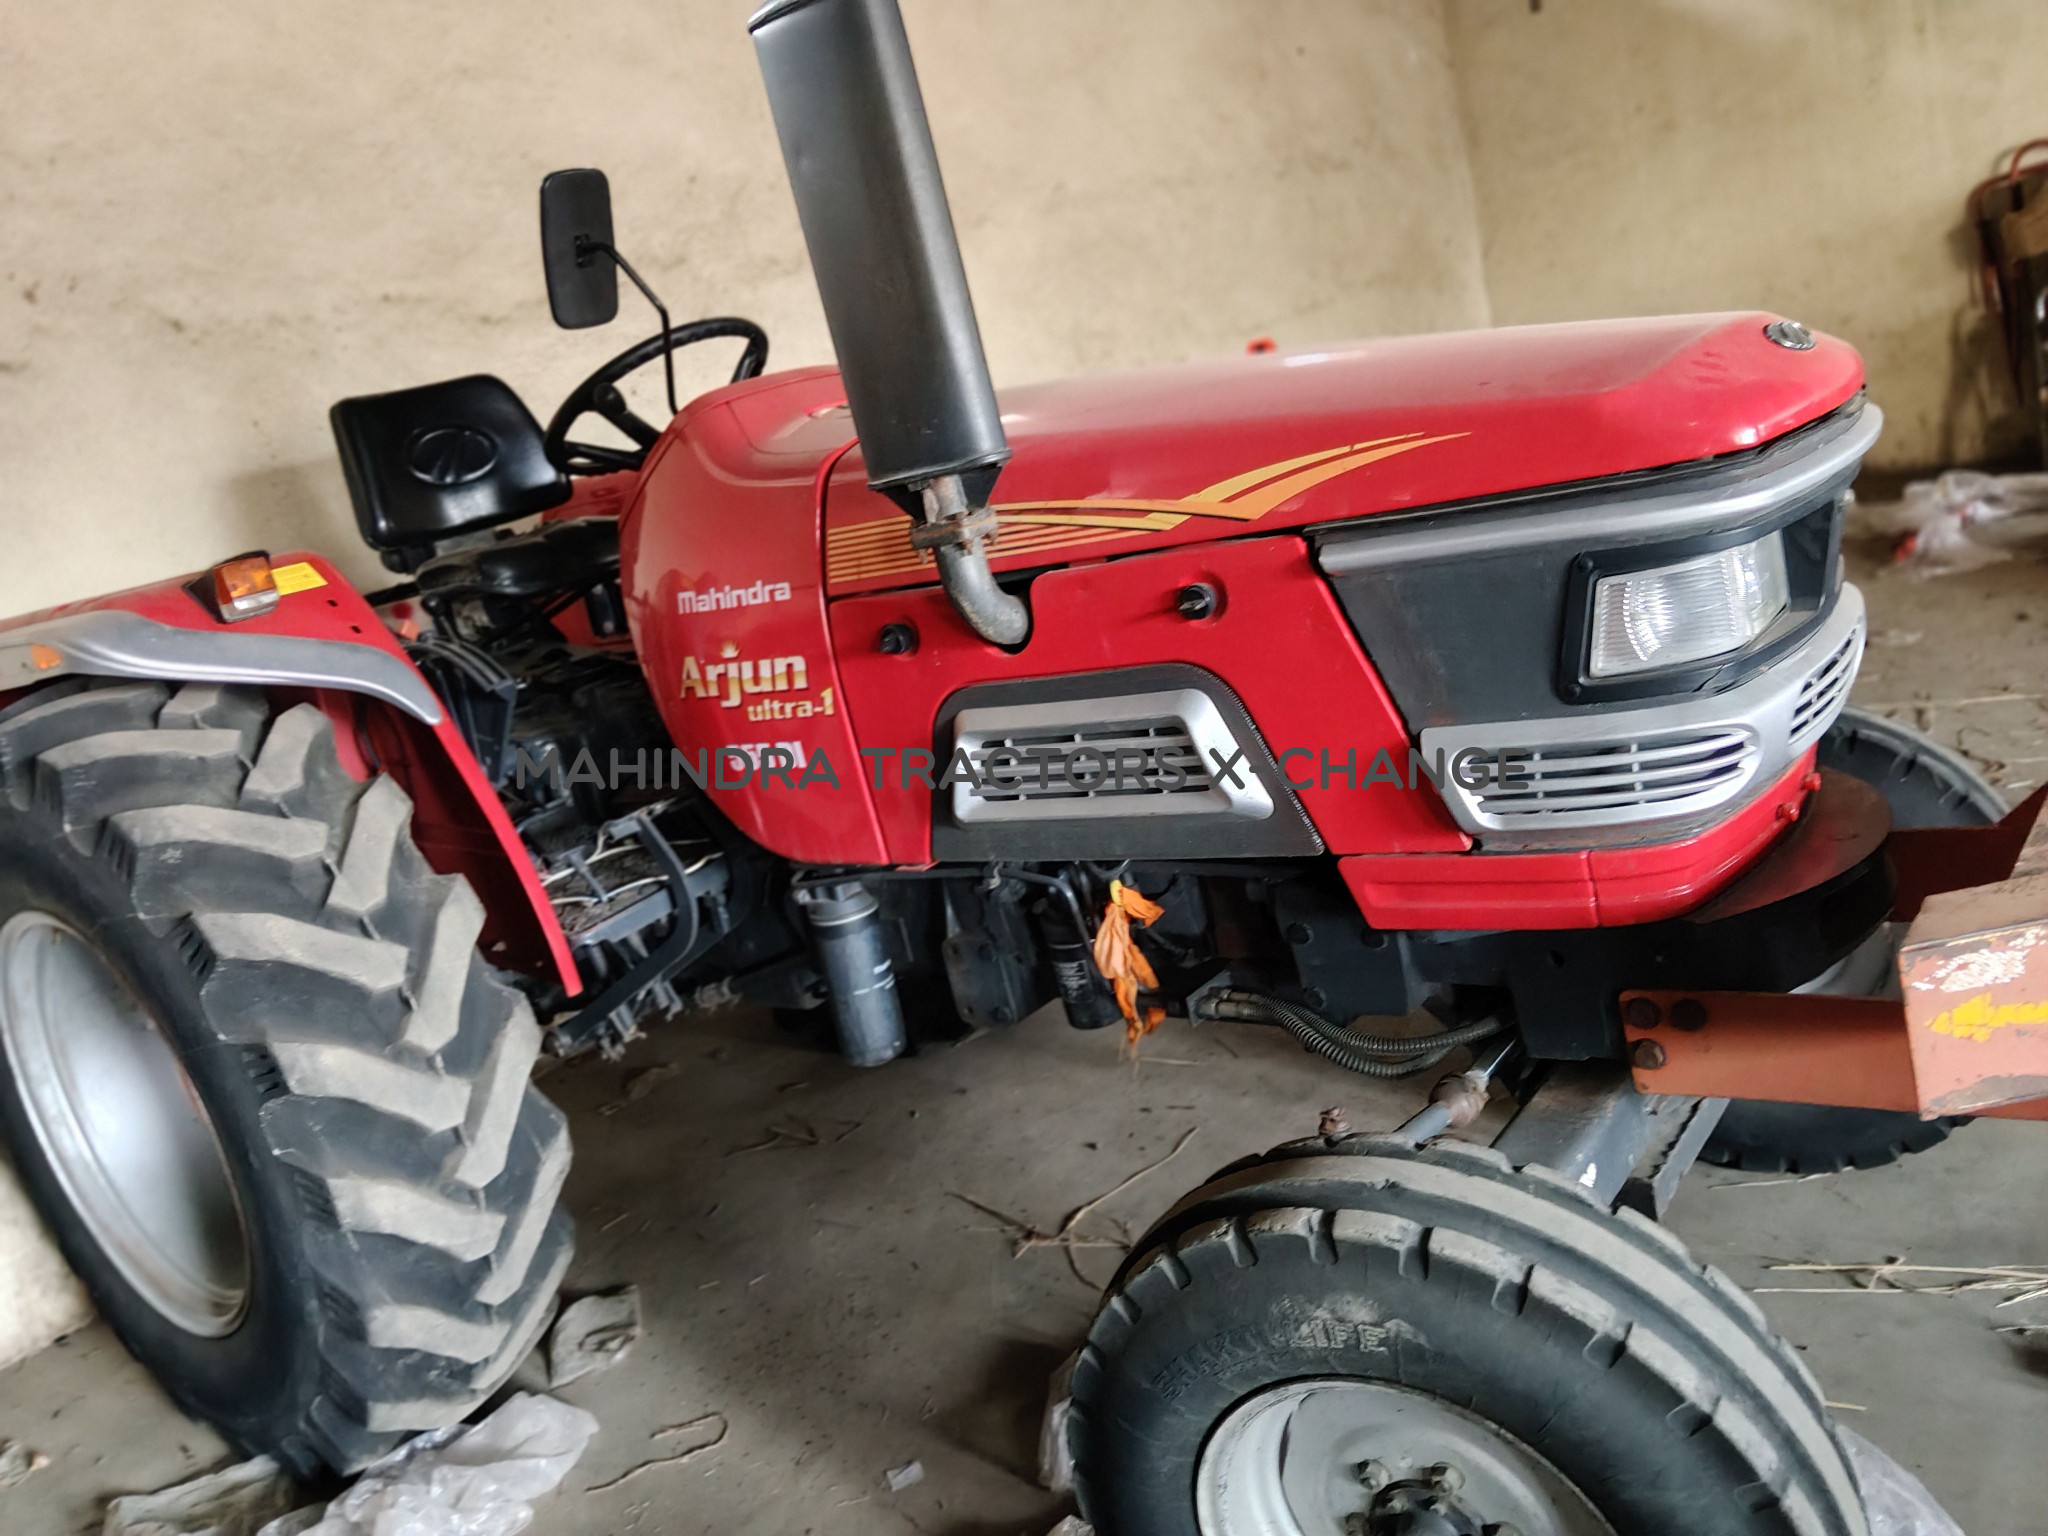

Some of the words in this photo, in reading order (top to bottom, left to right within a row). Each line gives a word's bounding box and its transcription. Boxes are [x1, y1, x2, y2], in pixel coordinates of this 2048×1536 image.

[677, 580, 791, 614] Mahindra
[680, 641, 808, 708] Arjun
[747, 687, 835, 722] ultra-1
